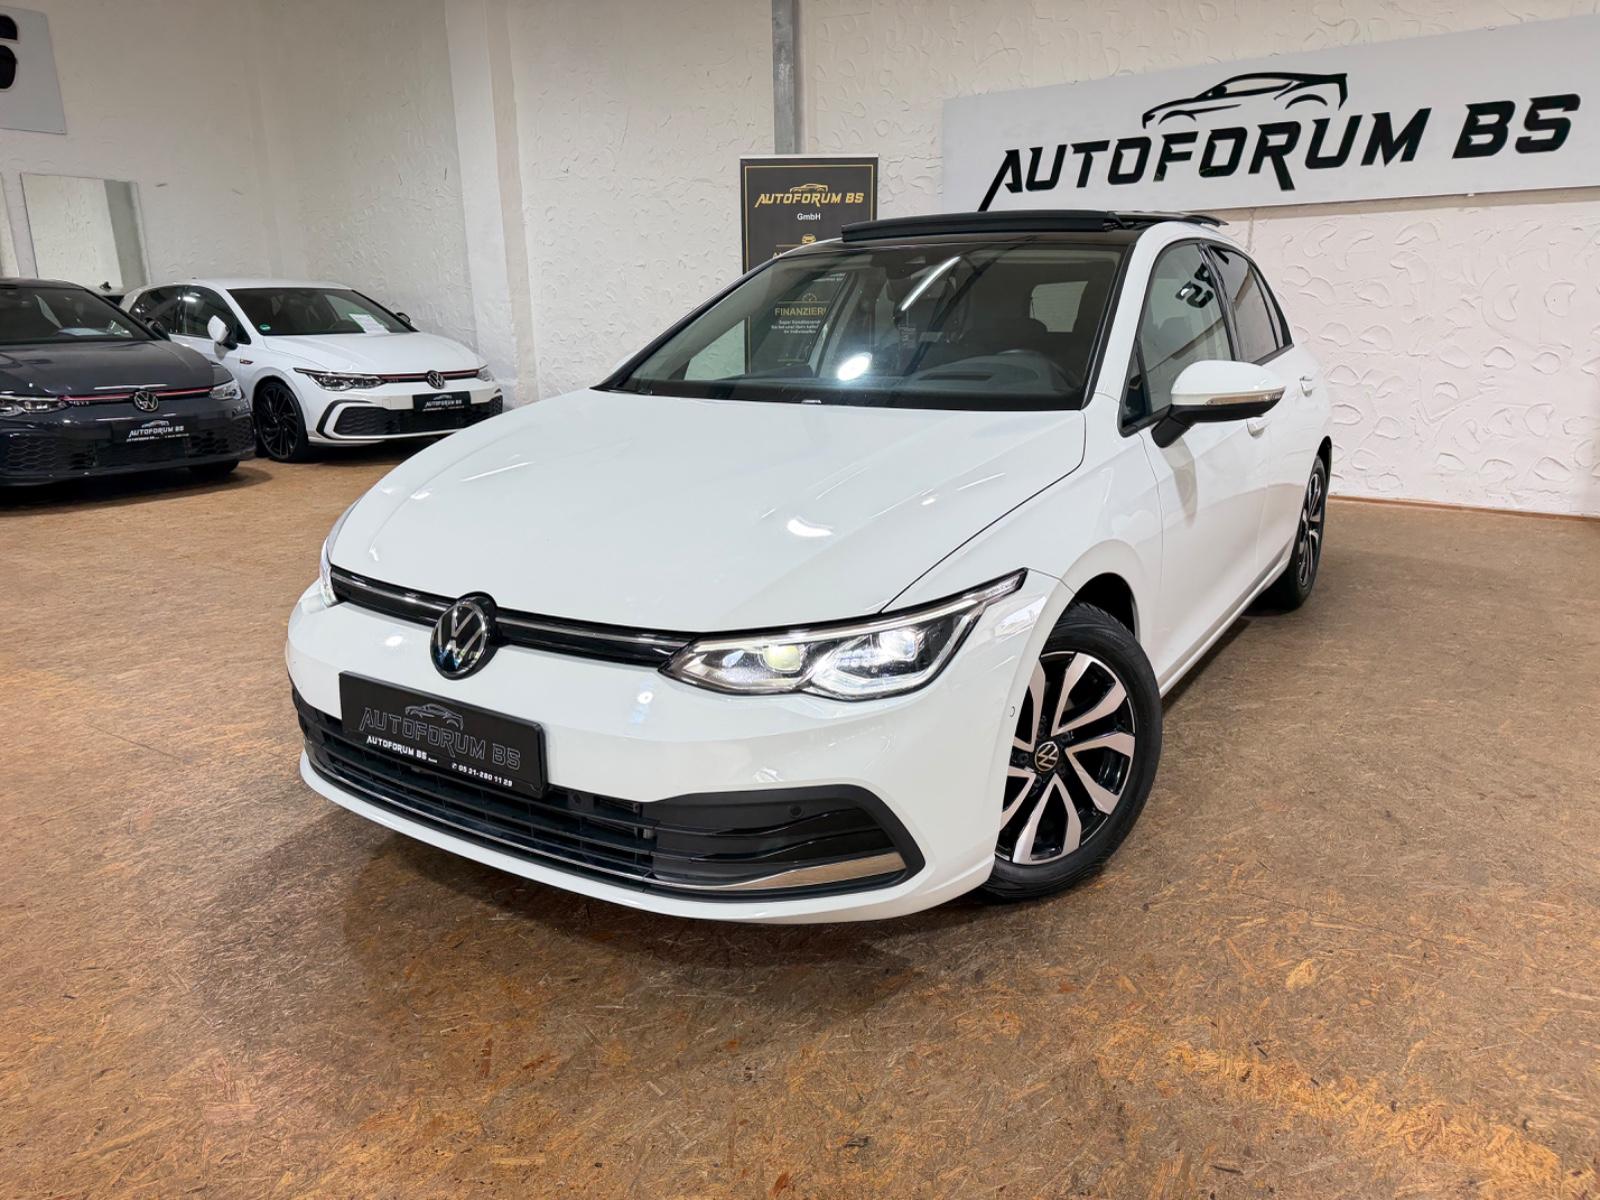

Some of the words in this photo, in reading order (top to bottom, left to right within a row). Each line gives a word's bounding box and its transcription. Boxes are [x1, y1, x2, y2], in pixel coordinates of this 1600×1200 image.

[978, 107, 1432, 211] AUTOFORUM
[1452, 93, 1581, 160] BS
[754, 193, 843, 208] AUTOFORUM
[845, 192, 865, 204] BS
[797, 212, 821, 221] GmbH
[775, 307, 827, 316] FINANZIER
[359, 707, 486, 760] AUTOFORUM
[492, 743, 521, 770] BS
[366, 735, 414, 756] AUTOFORUM
[416, 749, 428, 760] BS
